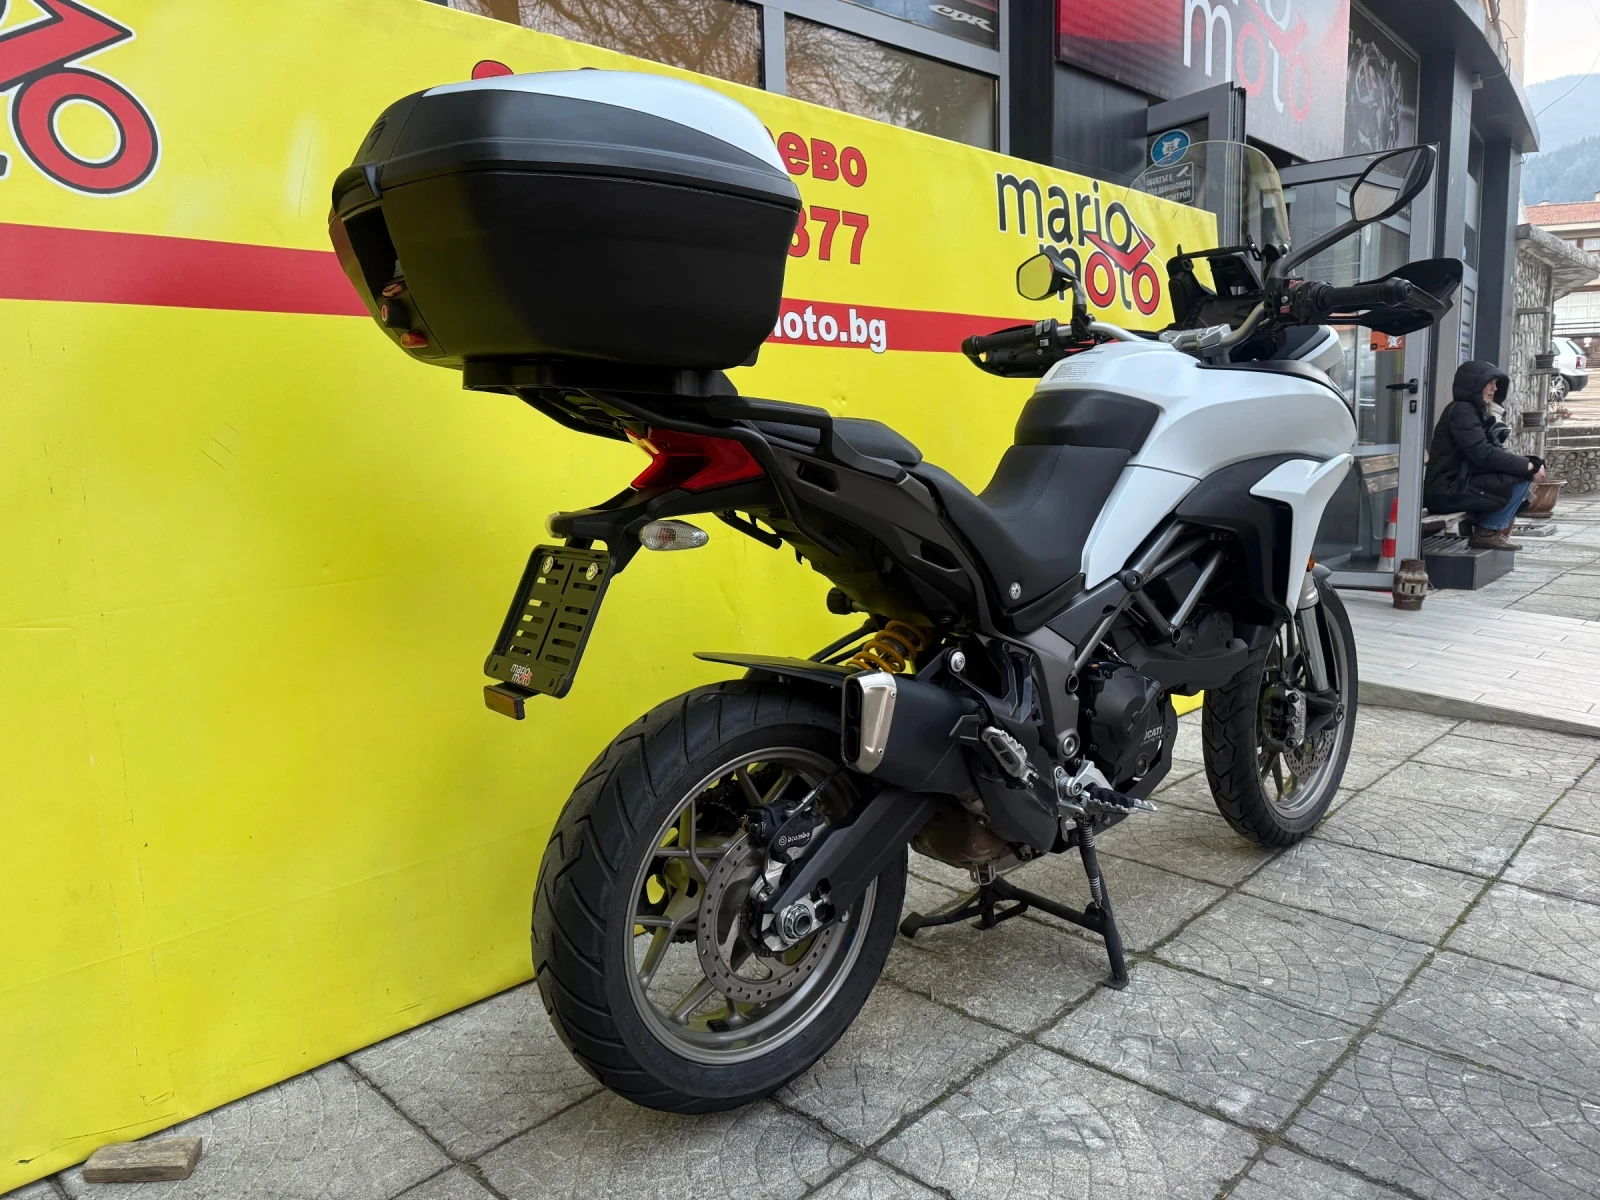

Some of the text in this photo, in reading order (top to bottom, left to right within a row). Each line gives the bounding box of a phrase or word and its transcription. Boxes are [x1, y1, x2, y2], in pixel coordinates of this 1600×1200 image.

[1183, 0, 1312, 123] moto
[764, 126, 868, 188] ево
[996, 173, 1133, 253] mario
[1038, 243, 1161, 316] moto
[511, 664, 531, 675] mario
[511, 674, 531, 686] moto
[787, 831, 810, 843] brembo
